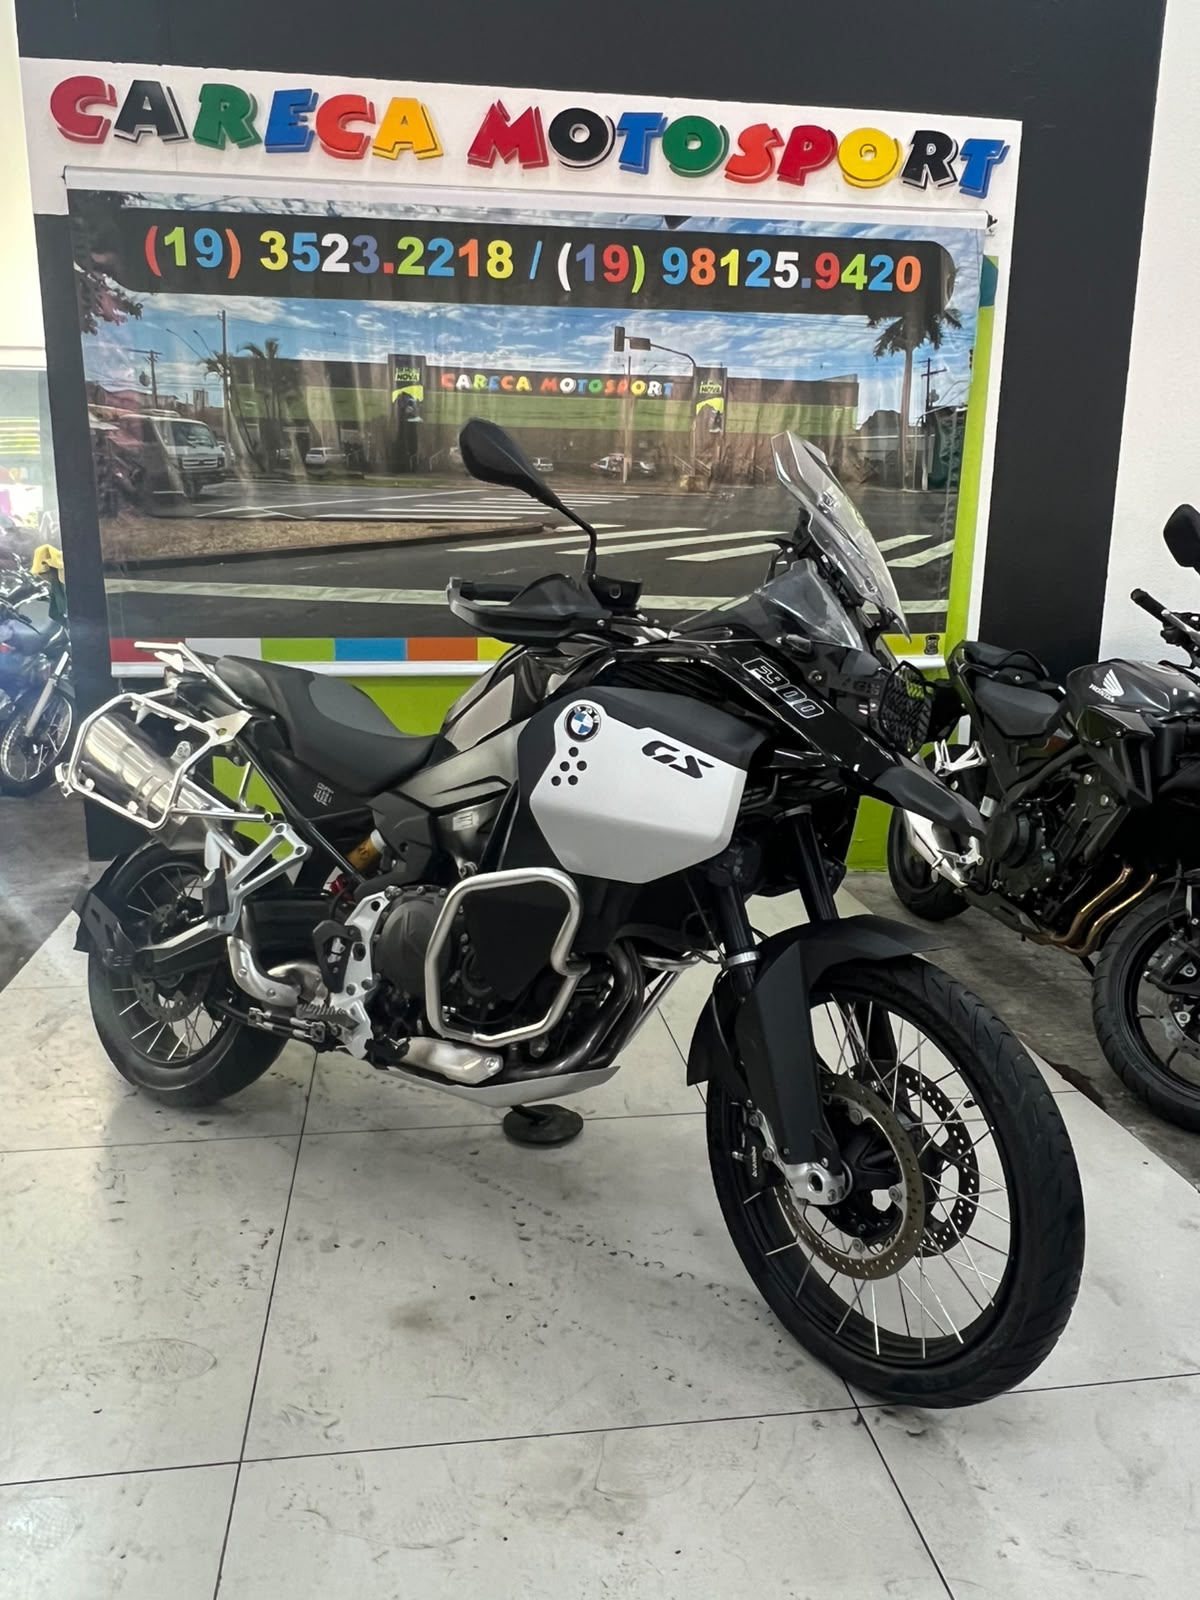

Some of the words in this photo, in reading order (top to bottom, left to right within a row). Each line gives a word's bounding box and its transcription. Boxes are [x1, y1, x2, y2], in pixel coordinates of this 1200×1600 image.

[50, 75, 443, 160] CARECA
[467, 99, 1011, 199] MOTOSPORT
[144, 225, 242, 279] (19)
[259, 229, 514, 280] 3523.2218
[557, 242, 646, 293] (19)
[662, 246, 922, 293] 98125.9420
[440, 372, 532, 393] CARECA
[540, 376, 673, 398] MOTOSPORT
[641, 740, 716, 779] GS
